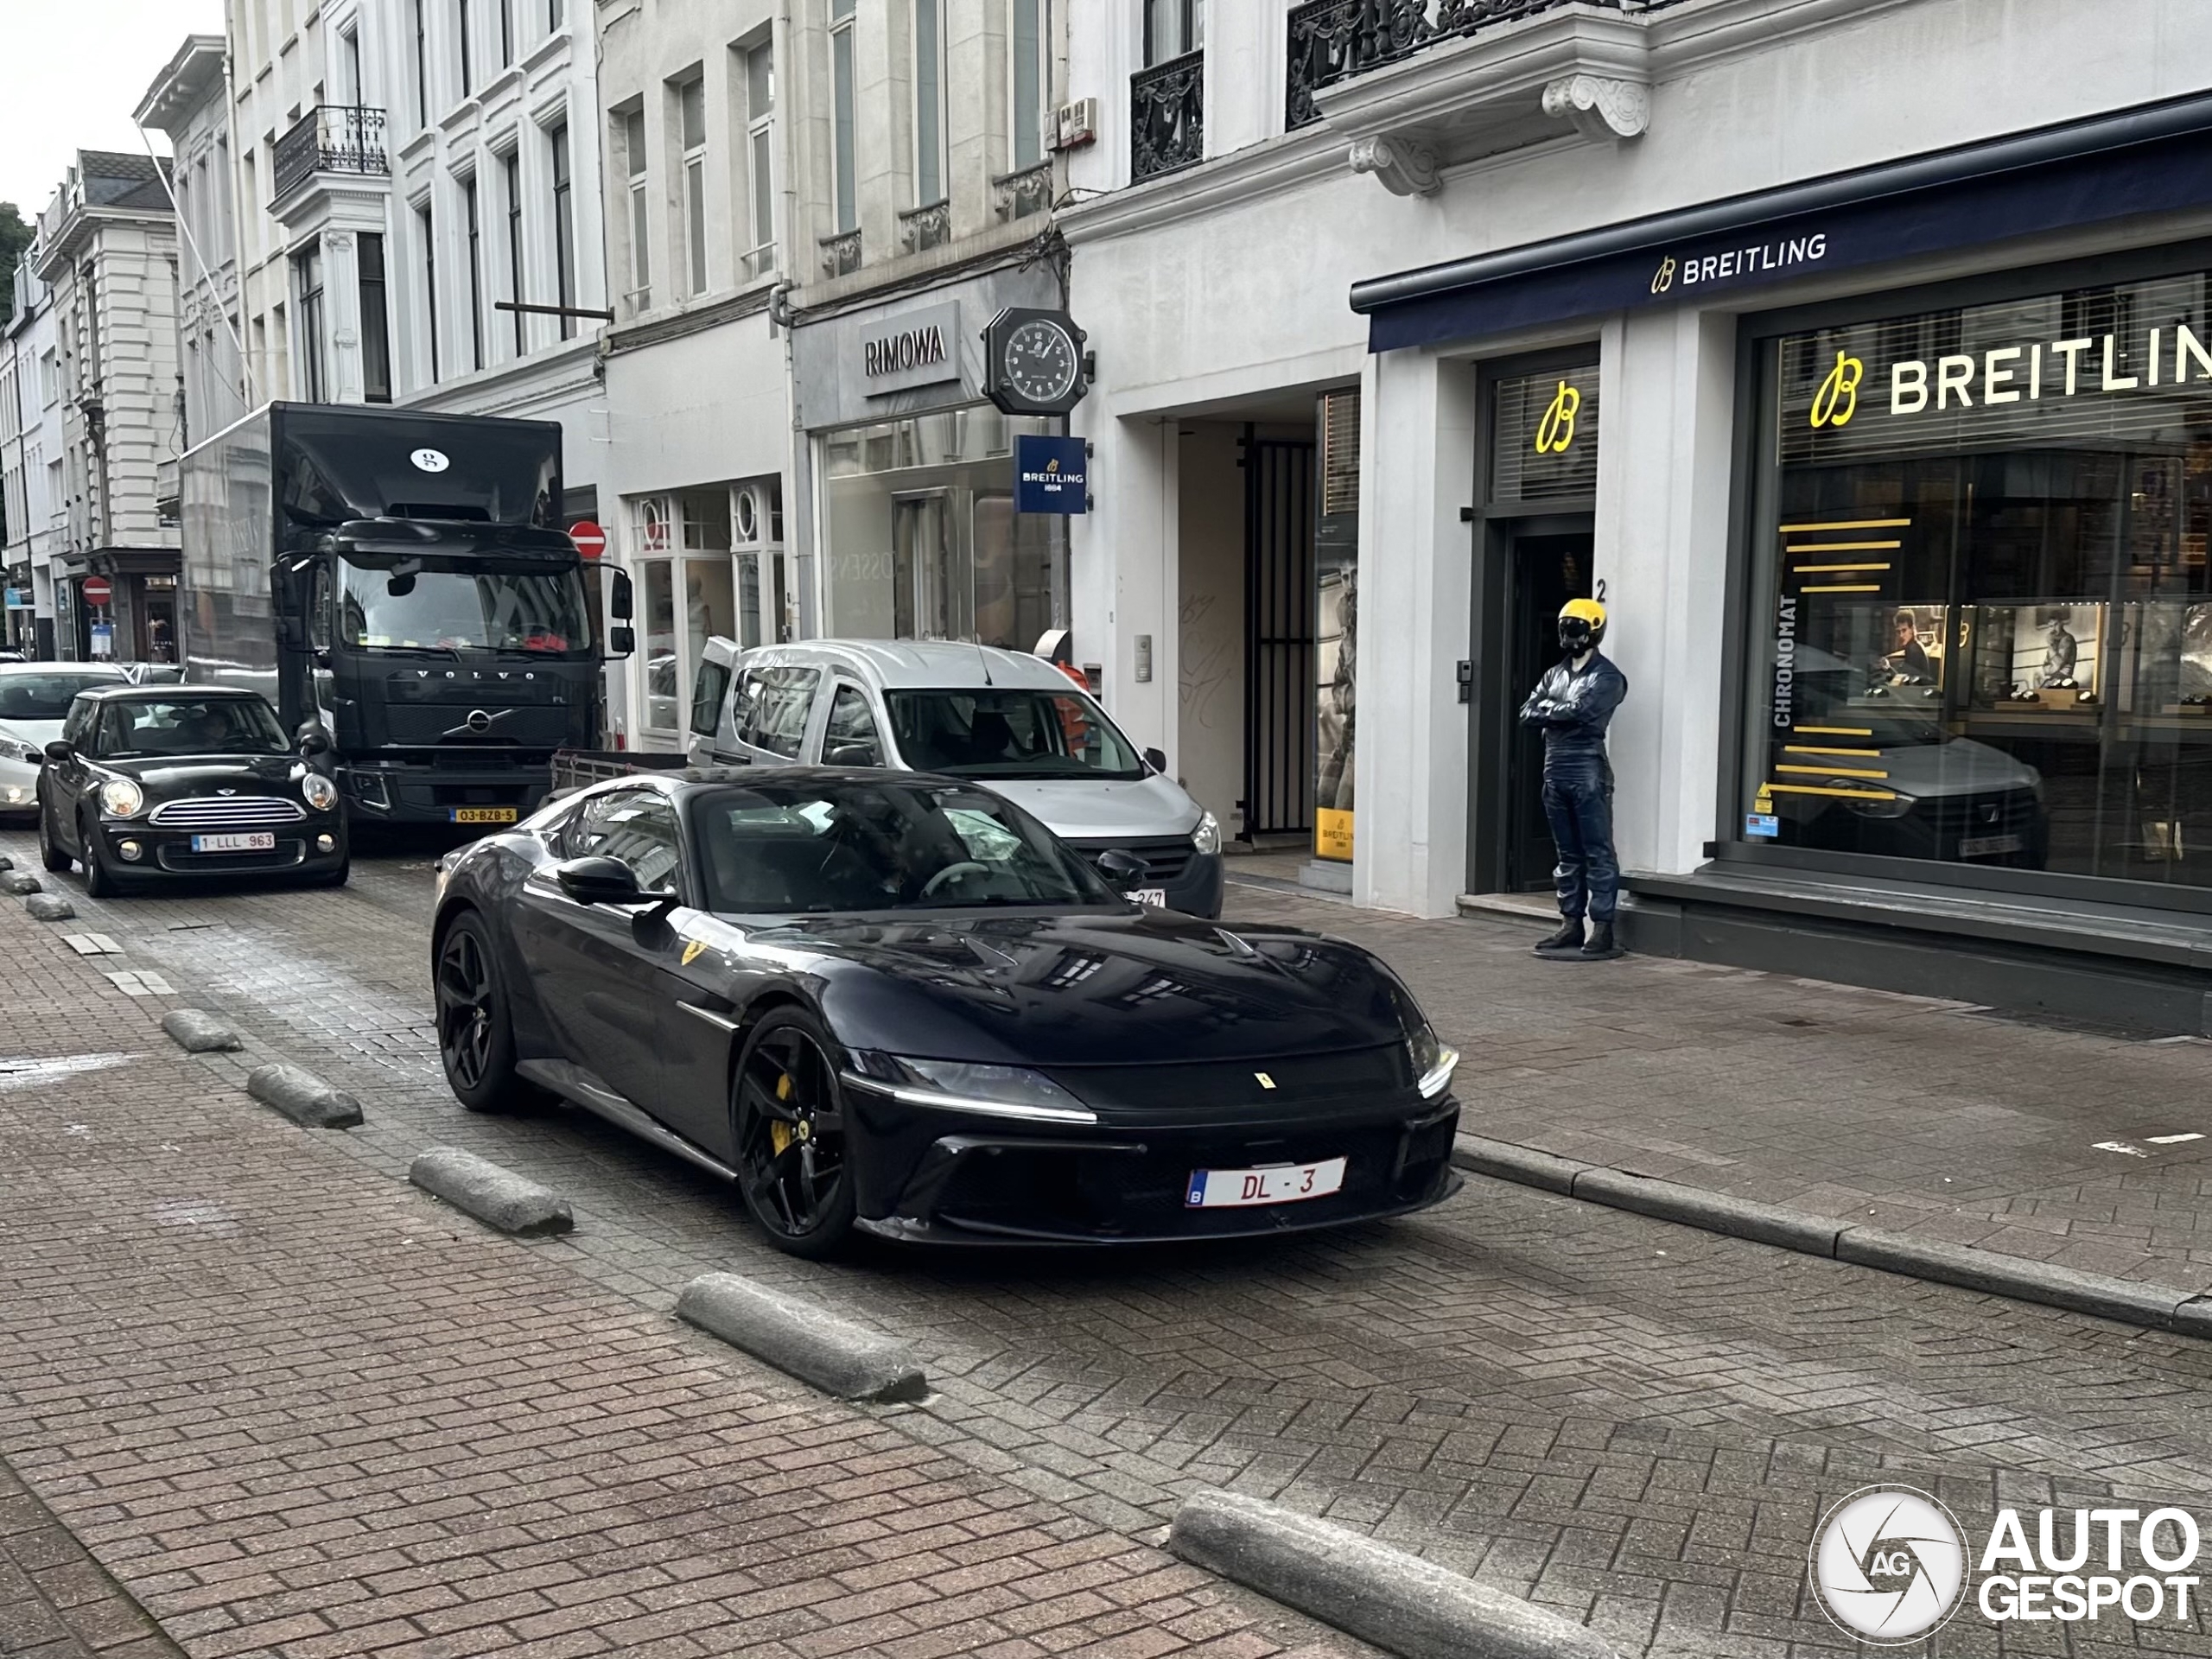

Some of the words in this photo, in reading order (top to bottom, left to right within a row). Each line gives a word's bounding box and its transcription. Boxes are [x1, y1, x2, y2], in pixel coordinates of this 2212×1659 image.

[1682, 233, 1827, 285] BREITLING
[865, 325, 946, 377] RIMOWA
[1022, 473, 1084, 484] BREITLING
[1597, 578, 1606, 603] 2
[1774, 594, 1796, 728] CHRONOMAT
[417, 671, 535, 680] VOLVO
[460, 810, 513, 821] 03-BZB-5
[1190, 1191, 1202, 1204] B
